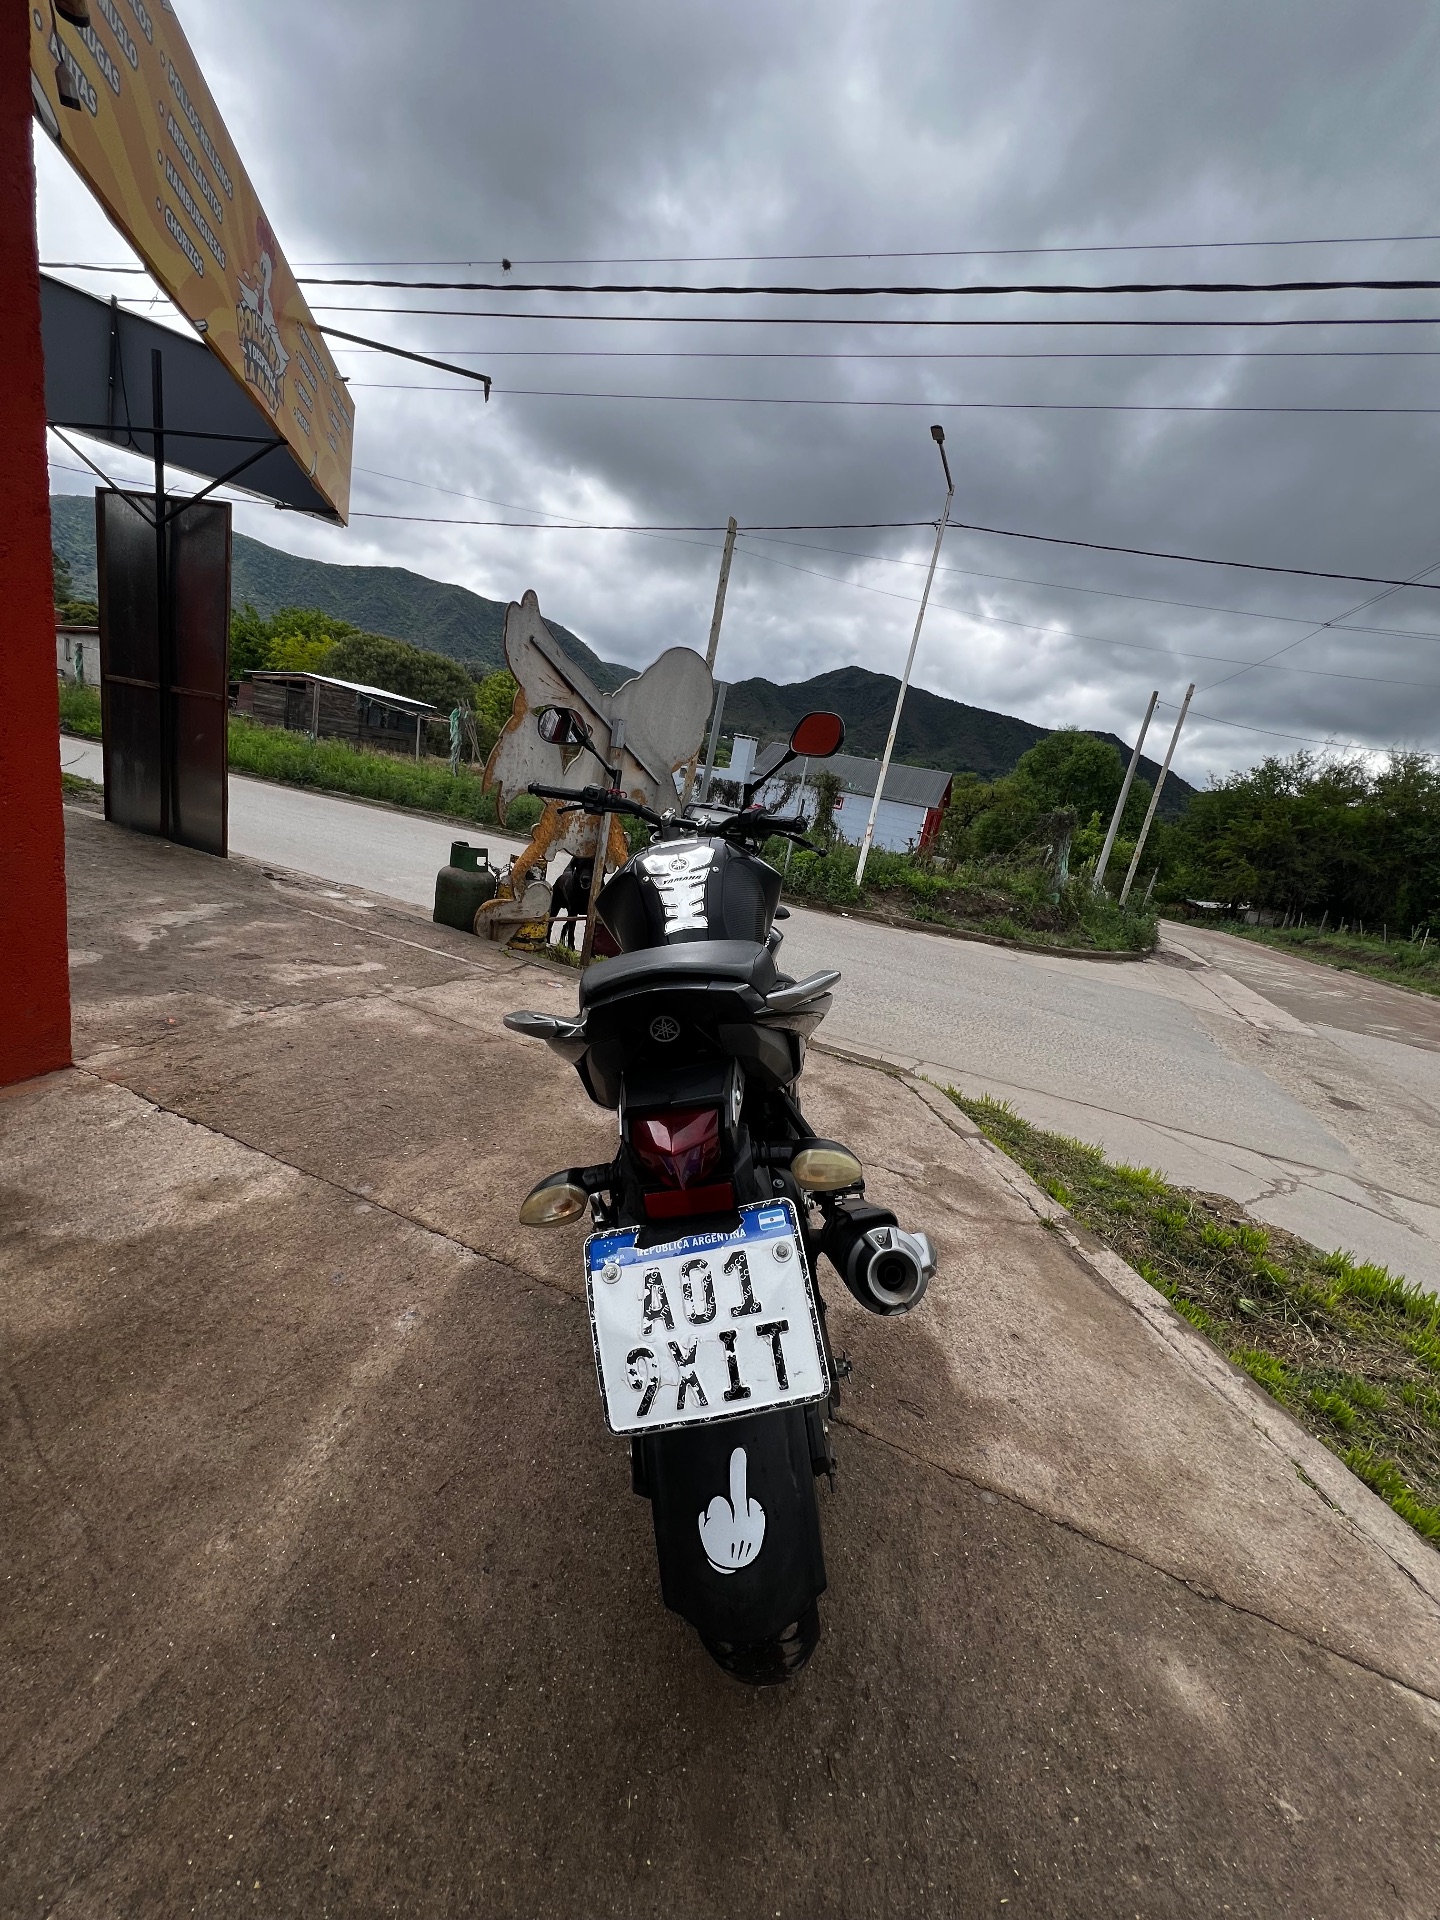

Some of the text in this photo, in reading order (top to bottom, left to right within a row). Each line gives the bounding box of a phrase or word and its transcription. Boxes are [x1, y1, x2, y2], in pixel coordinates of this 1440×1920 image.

[166, 109, 222, 225] ARROLLADITOS
[168, 60, 233, 199] POLLOS RELLENOS
[163, 206, 204, 277] CHORIZOS
[164, 154, 227, 270] HAMBURGUESAS
[663, 875, 702, 885] YAMAHA
[691, 1229, 747, 1247] ARGENTINA
[642, 1250, 762, 1336] A01
[625, 1319, 790, 1418] 9XIT
